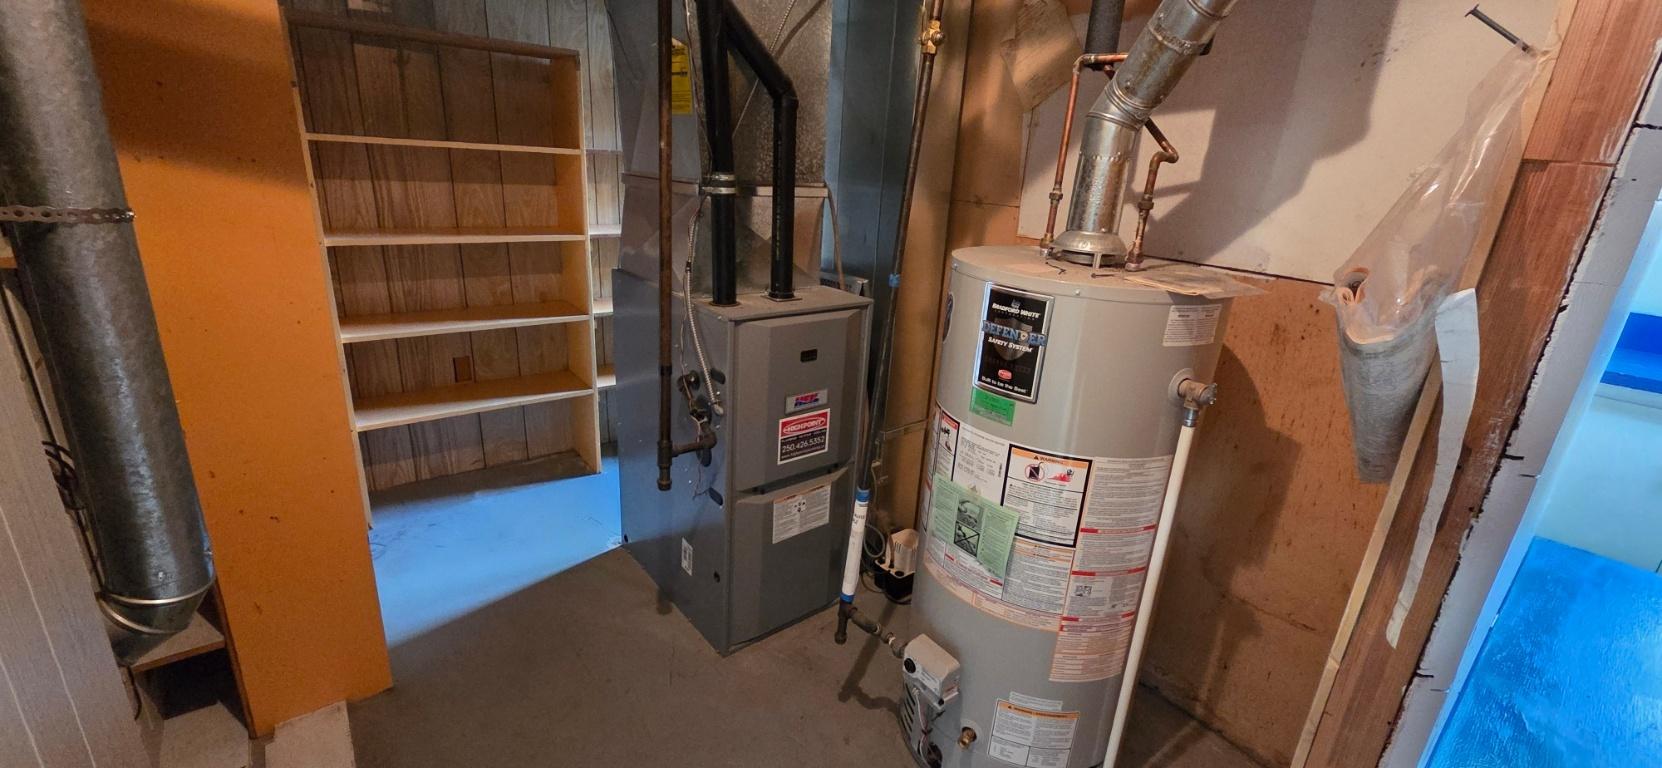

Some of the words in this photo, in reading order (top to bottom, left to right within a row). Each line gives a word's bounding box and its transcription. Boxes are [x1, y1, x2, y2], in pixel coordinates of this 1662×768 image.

[991, 302, 1020, 314] BRADFORD
[1020, 309, 1041, 318] WHITE
[981, 319, 1048, 347] DEFENDER
[988, 336, 1008, 347] SAFETY
[1008, 342, 1034, 353] SYSTEM
[787, 419, 822, 432] HIGHPOINT
